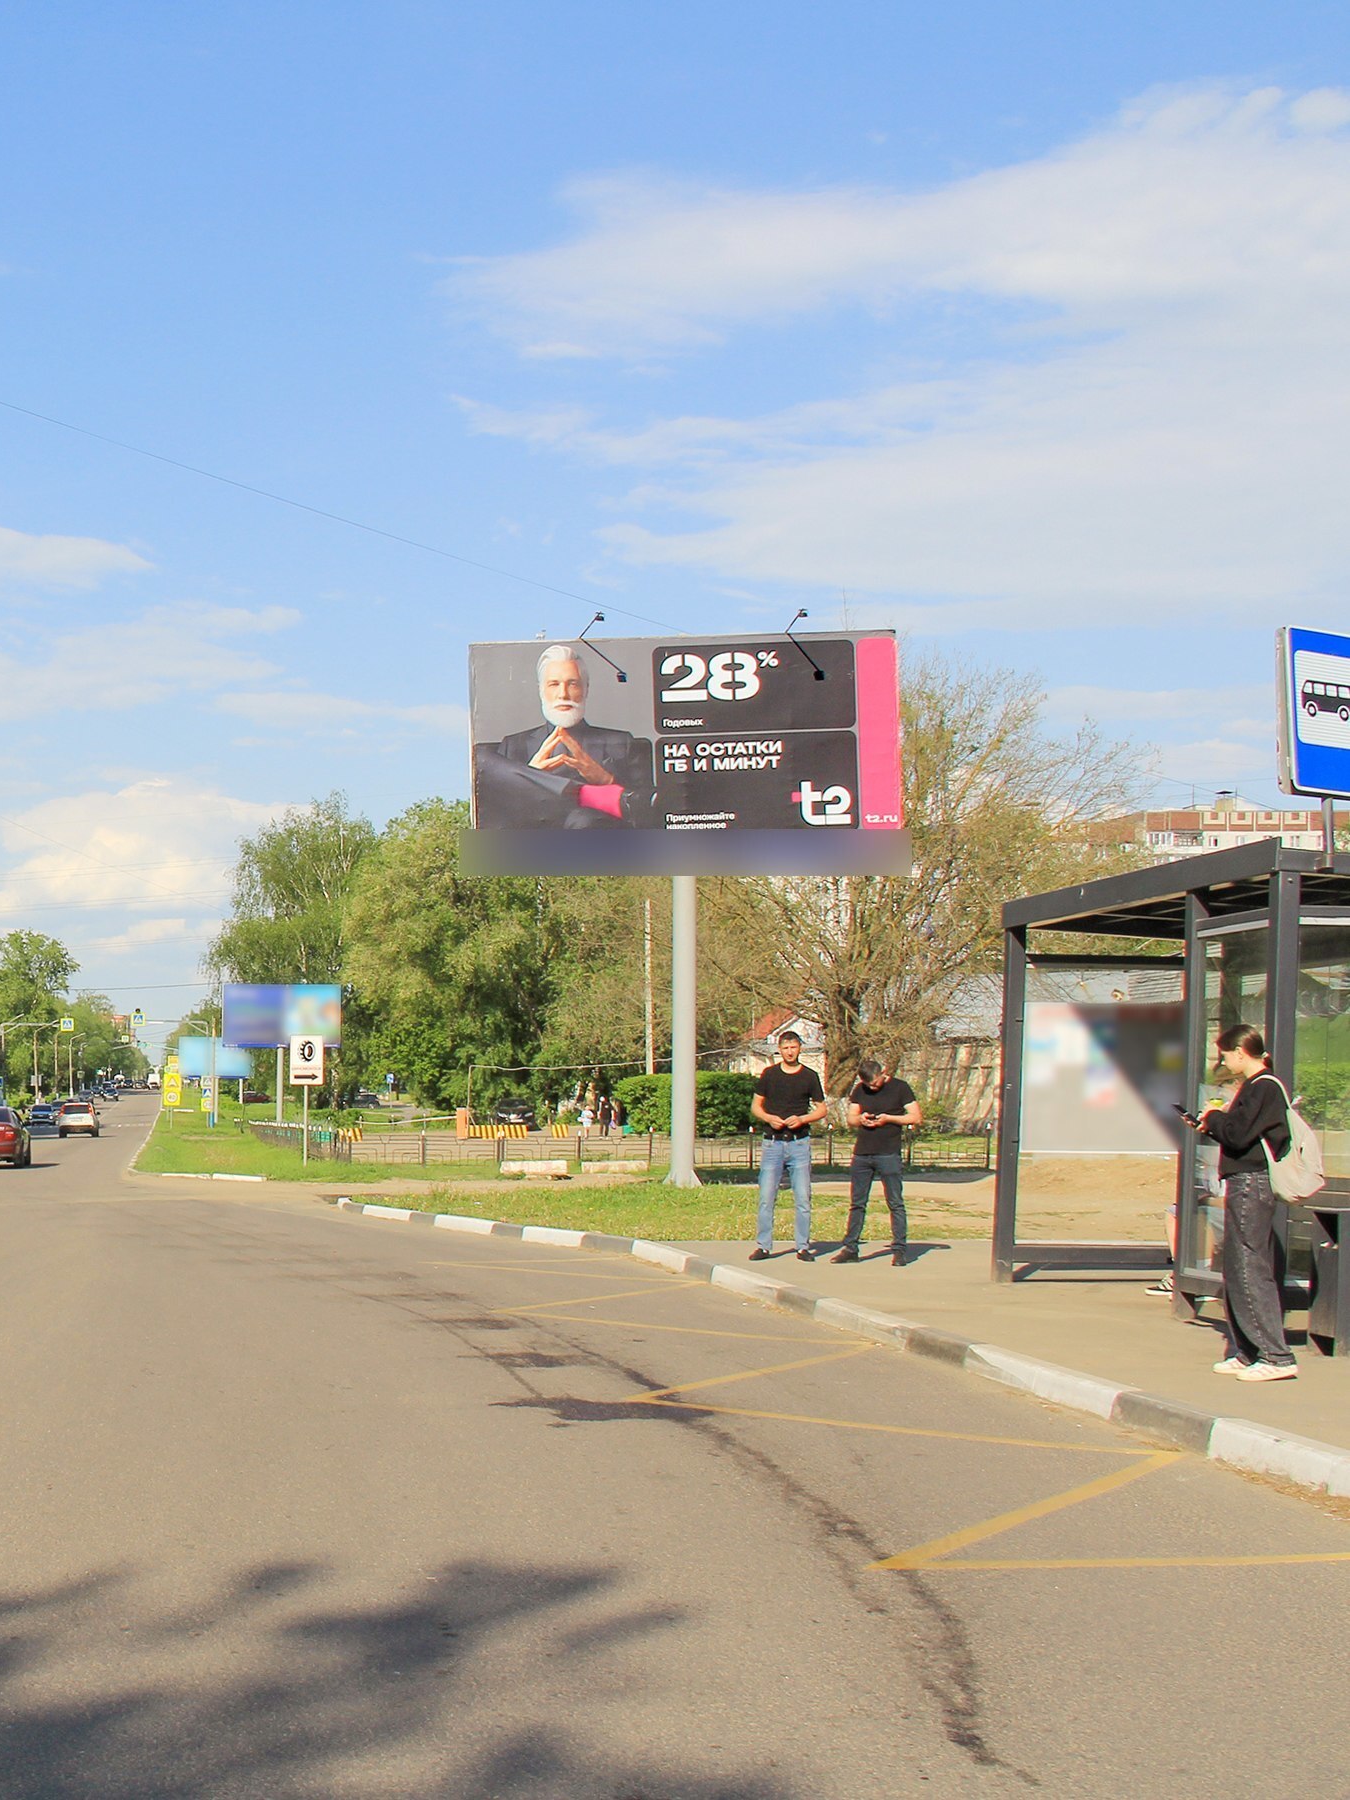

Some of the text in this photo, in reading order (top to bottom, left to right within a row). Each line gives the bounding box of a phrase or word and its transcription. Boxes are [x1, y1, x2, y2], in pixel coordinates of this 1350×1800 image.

[660, 651, 779, 702] 28%
[662, 718, 704, 728] Годовых
[663, 740, 783, 758] НА ОСТАТКИ
[663, 755, 781, 772] ГБ И МИНУТ
[792, 781, 852, 826] t2
[665, 812, 736, 823] Приумножайте
[864, 813, 899, 823] t2.ru
